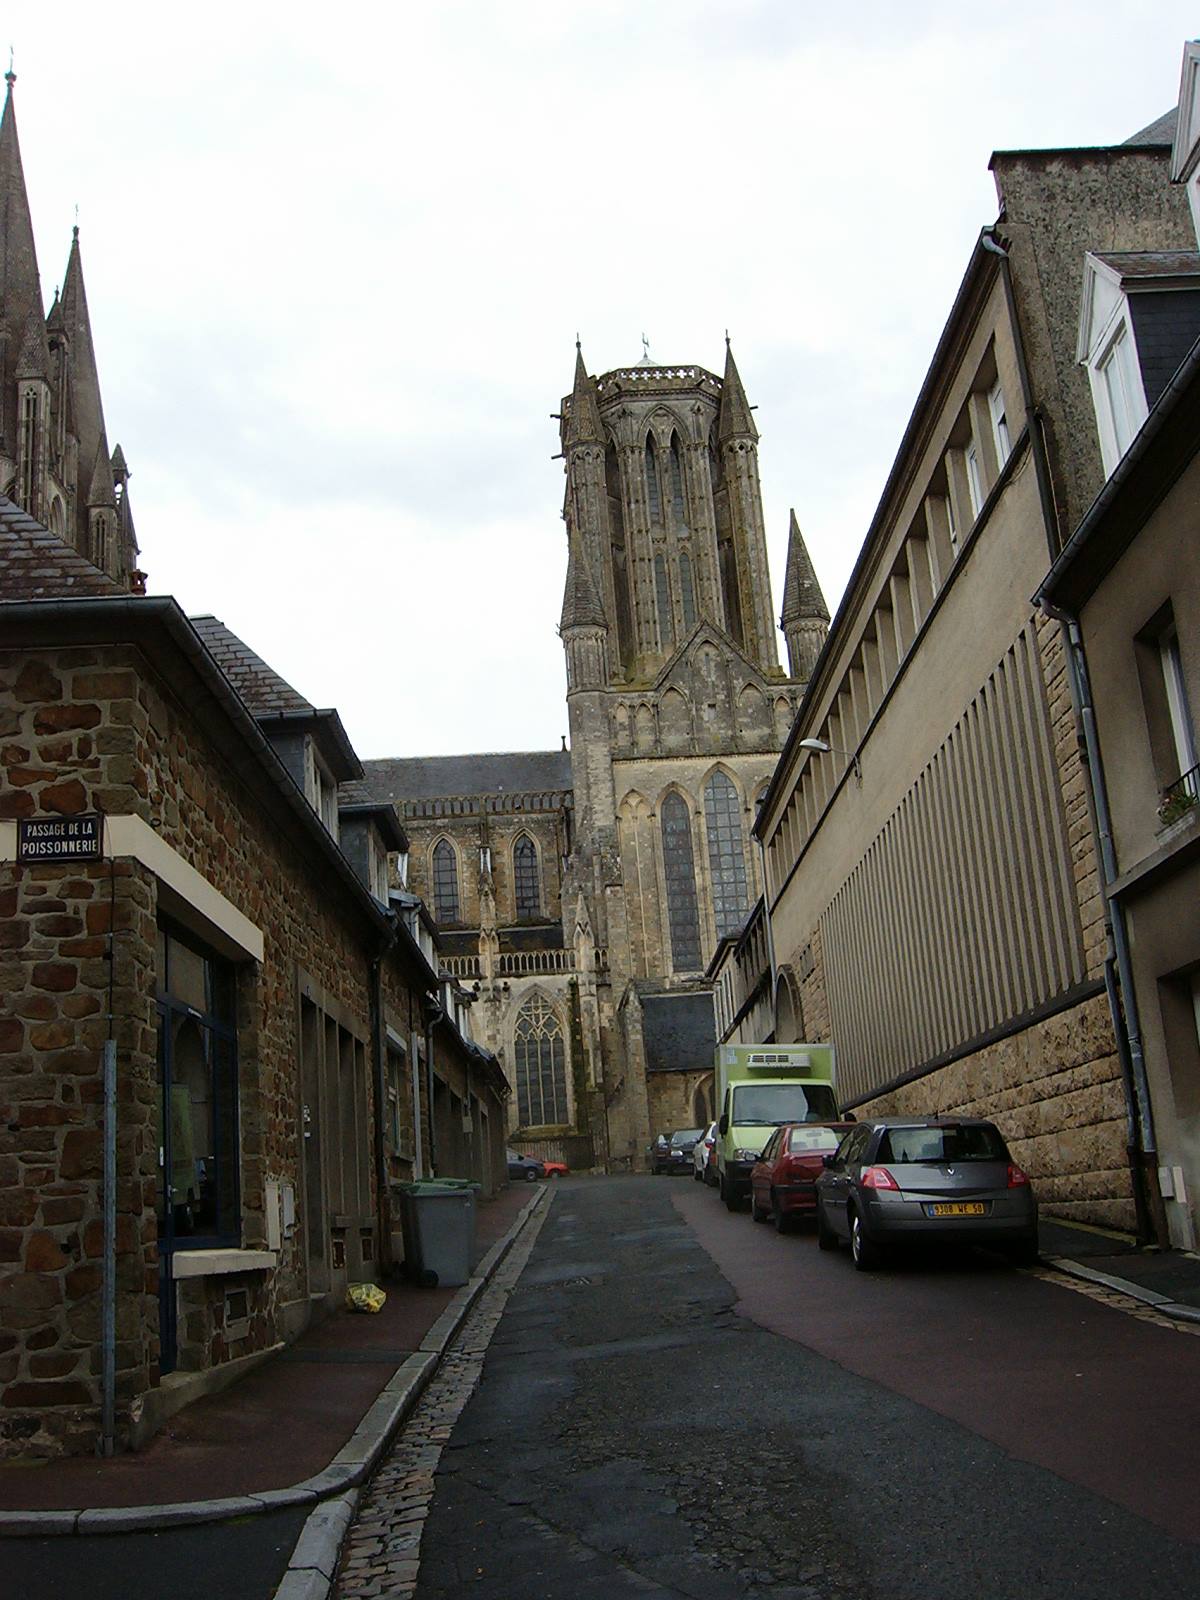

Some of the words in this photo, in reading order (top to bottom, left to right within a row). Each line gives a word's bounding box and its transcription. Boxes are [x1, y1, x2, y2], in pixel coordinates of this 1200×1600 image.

[27, 824, 65, 837] PASSAGE
[68, 822, 79, 835] DE
[82, 822, 93, 834] LA
[22, 839, 97, 855] POISSONNERIE
